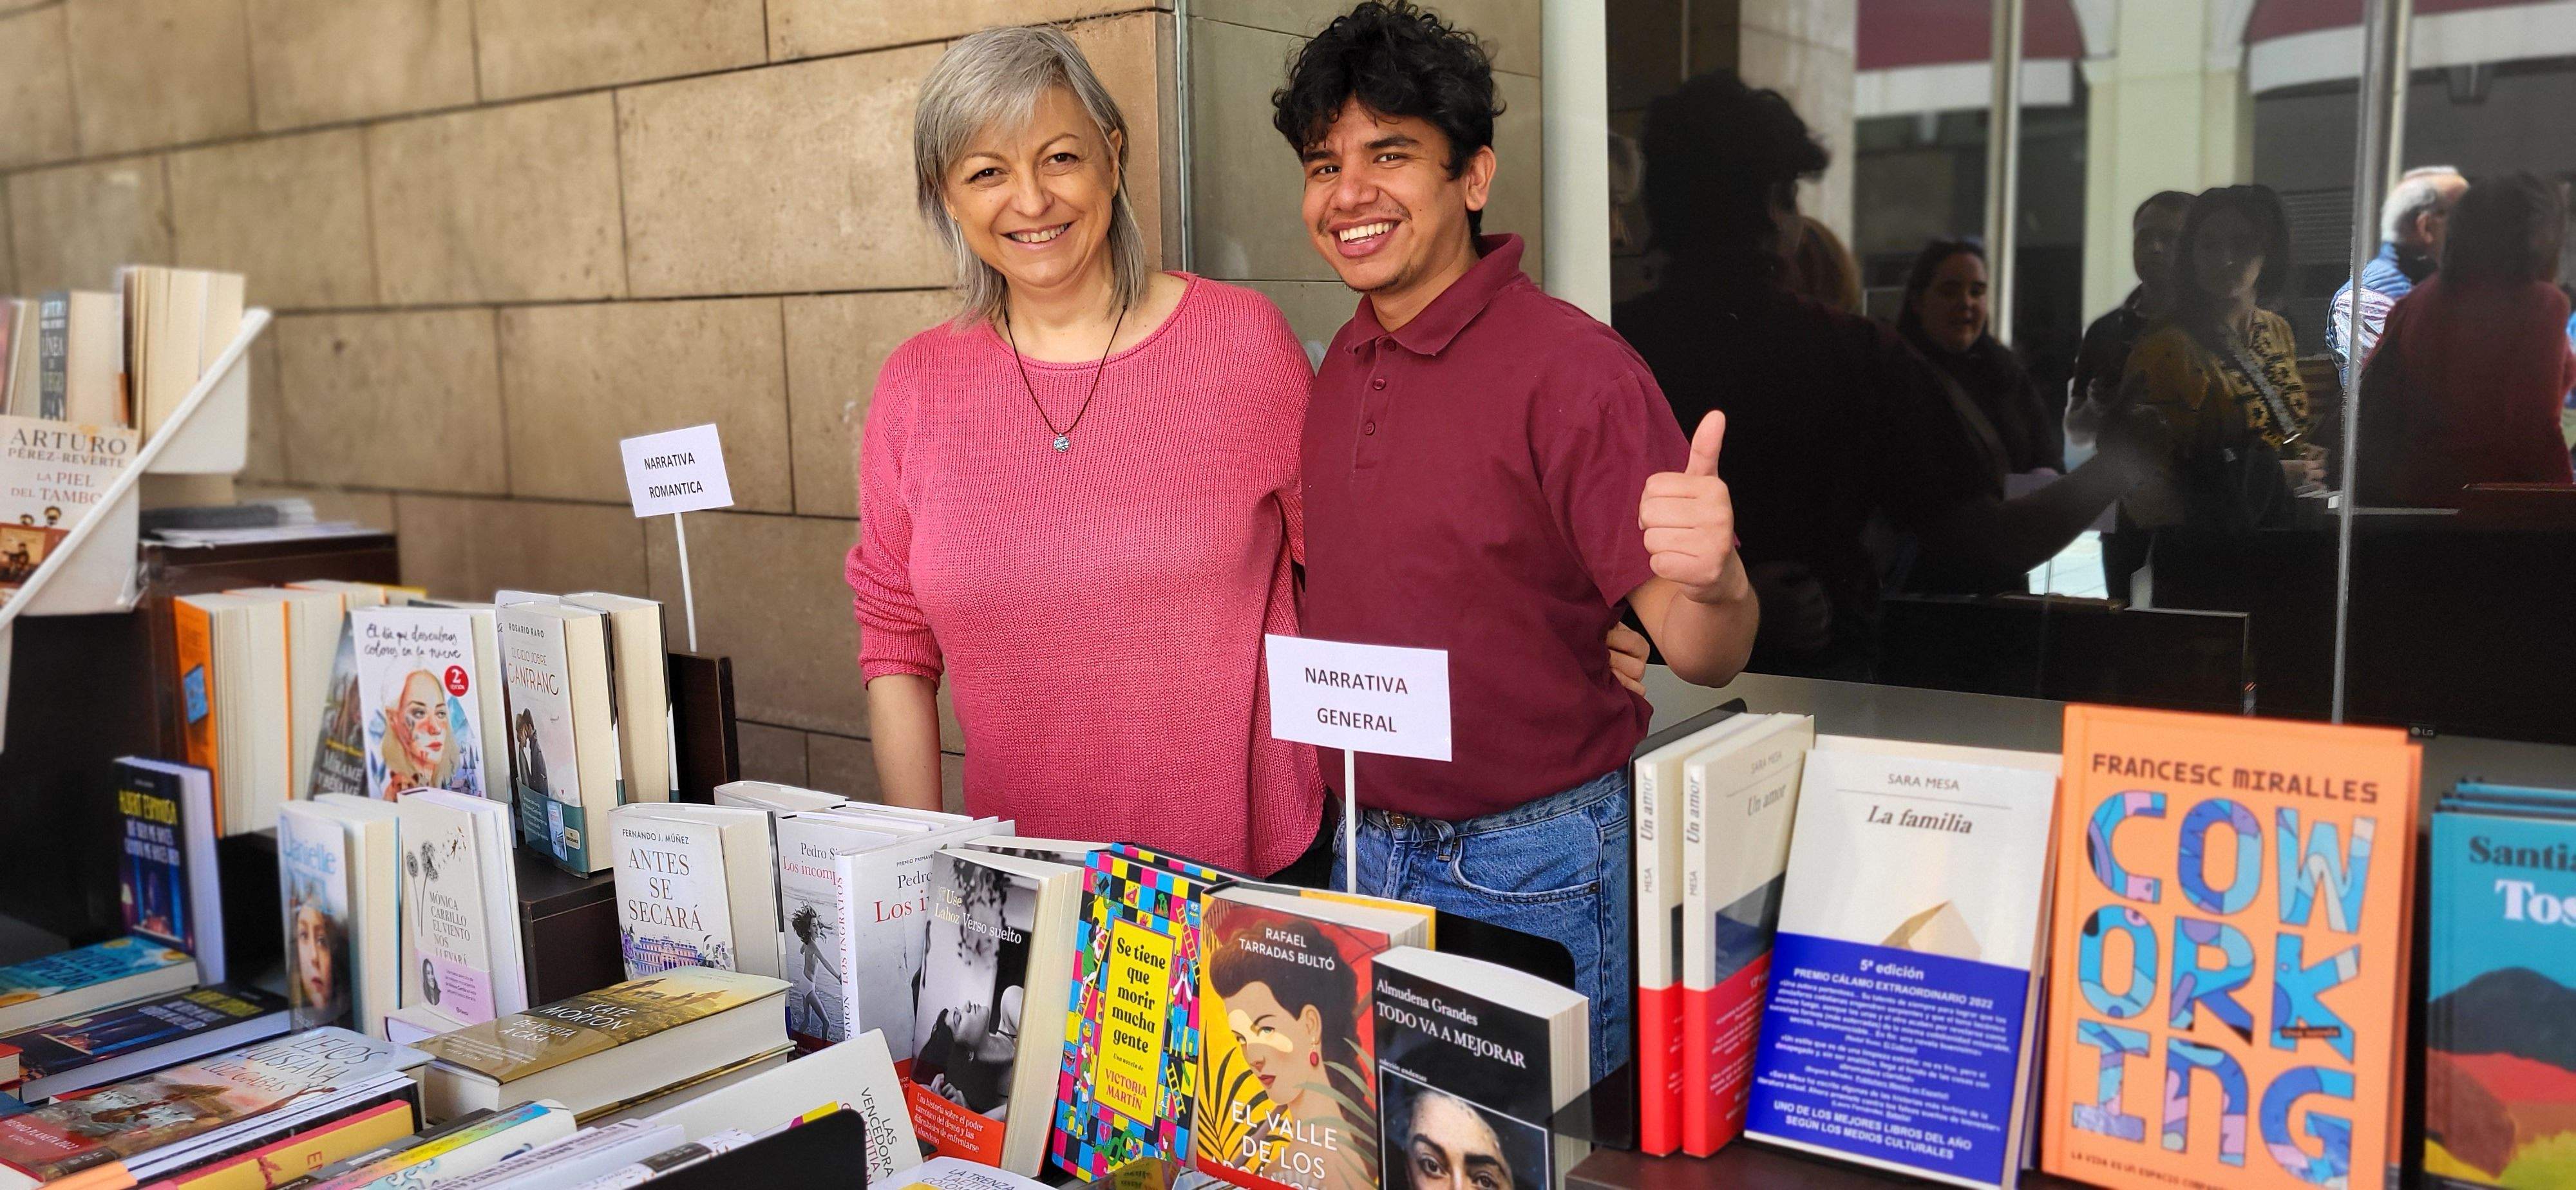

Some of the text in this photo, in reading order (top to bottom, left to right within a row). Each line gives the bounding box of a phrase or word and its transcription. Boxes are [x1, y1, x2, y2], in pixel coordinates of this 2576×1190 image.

[11, 427, 128, 457] ARTURO
[8, 446, 125, 469] PÉREZ-REVERTE
[644, 452, 696, 471] NARRATIVA
[11, 487, 35, 499] DEL
[37, 471, 95, 489] LA PIEL
[649, 480, 704, 499] ROMANTICA
[509, 623, 529, 634] ROSARIO
[531, 628, 545, 638] RARO
[507, 663, 560, 695] CANFRANC
[1305, 667, 1408, 695] NARRATIVA
[1317, 708, 1397, 733] GENERAL
[1888, 773, 1960, 792] SARA MESA
[2092, 753, 2380, 804] FRANCESC MIRALLES
[1640, 773, 1654, 842] Un amor
[1686, 776, 1701, 844] Un amor
[1748, 784, 1786, 817] Un amor
[1866, 804, 1973, 835] La familia
[623, 829, 690, 845] FERNANDO J. MÚÑEZ
[629, 847, 690, 876] ANTES
[783, 855, 799, 873] Los
[800, 842, 838, 861] Pedro S
[649, 876, 674, 900] SE
[1644, 867, 1653, 893] MESA
[1689, 871, 1698, 896] MESA
[430, 891, 459, 911] MÓNICA
[875, 899, 913, 923] Los
[947, 889, 962, 907] Use
[431, 905, 467, 927] CARRILLO
[629, 899, 704, 932] SECARÁ
[837, 876, 848, 953] INGRATOS
[433, 920, 470, 941] EL VIENTO
[434, 933, 450, 949] NOS
[962, 912, 987, 934] Verso
[989, 926, 1022, 944] suelto
[1265, 927, 1307, 948] RAFAEL
[1116, 937, 1166, 970] Se tiene
[1238, 938, 1335, 971] TARRADAS BULTÓ
[1127, 965, 1150, 985] que
[1875, 963, 1925, 981] edición
[1117, 985, 1155, 1011] morir
[1794, 968, 1994, 1010] PREMIO CÁLAMO EXTRAORDINARIO 2022
[585, 1003, 638, 1017] KATE
[1377, 978, 1479, 1027] Almudena Grandes
[513, 1019, 577, 1039] DE VUELTA
[540, 1006, 632, 1030] MORTON
[1112, 1006, 1155, 1034] mucha
[512, 1030, 549, 1044] CASA
[1113, 1029, 1149, 1053] gente
[1377, 1001, 1527, 1069] TODO VA A MEJORAR
[290, 1035, 388, 1064] LEJOS
[1113, 1053, 1122, 1062] Una
[1122, 1057, 1138, 1070] novela
[236, 1045, 350, 1084] LUISIANA
[1105, 1068, 1148, 1099] VICTORIA
[1106, 1084, 1142, 1111] MARTÍN
[917, 1092, 984, 1133] Una historia sobre el poder
[1232, 1100, 1338, 1151] EL VALLE
[1774, 1100, 1973, 1151] UNO DE LOS MEJORES LIBROS DEL AÑO
[861, 1087, 895, 1178] VENCEDORA
[882, 1118, 898, 1146] LAS
[940, 1126, 947, 1138] de
[947, 1131, 980, 1153] enfrentarse
[945, 1120, 960, 1133] deseo
[961, 1128, 965, 1136] y
[965, 1128, 975, 1140] las
[1785, 1113, 1955, 1160] SEGÚN LOS MEDIOS CULTURALES
[1242, 1135, 1271, 1164] DE
[1280, 1146, 1326, 1180] LOS
[949, 1168, 967, 1177] LA
